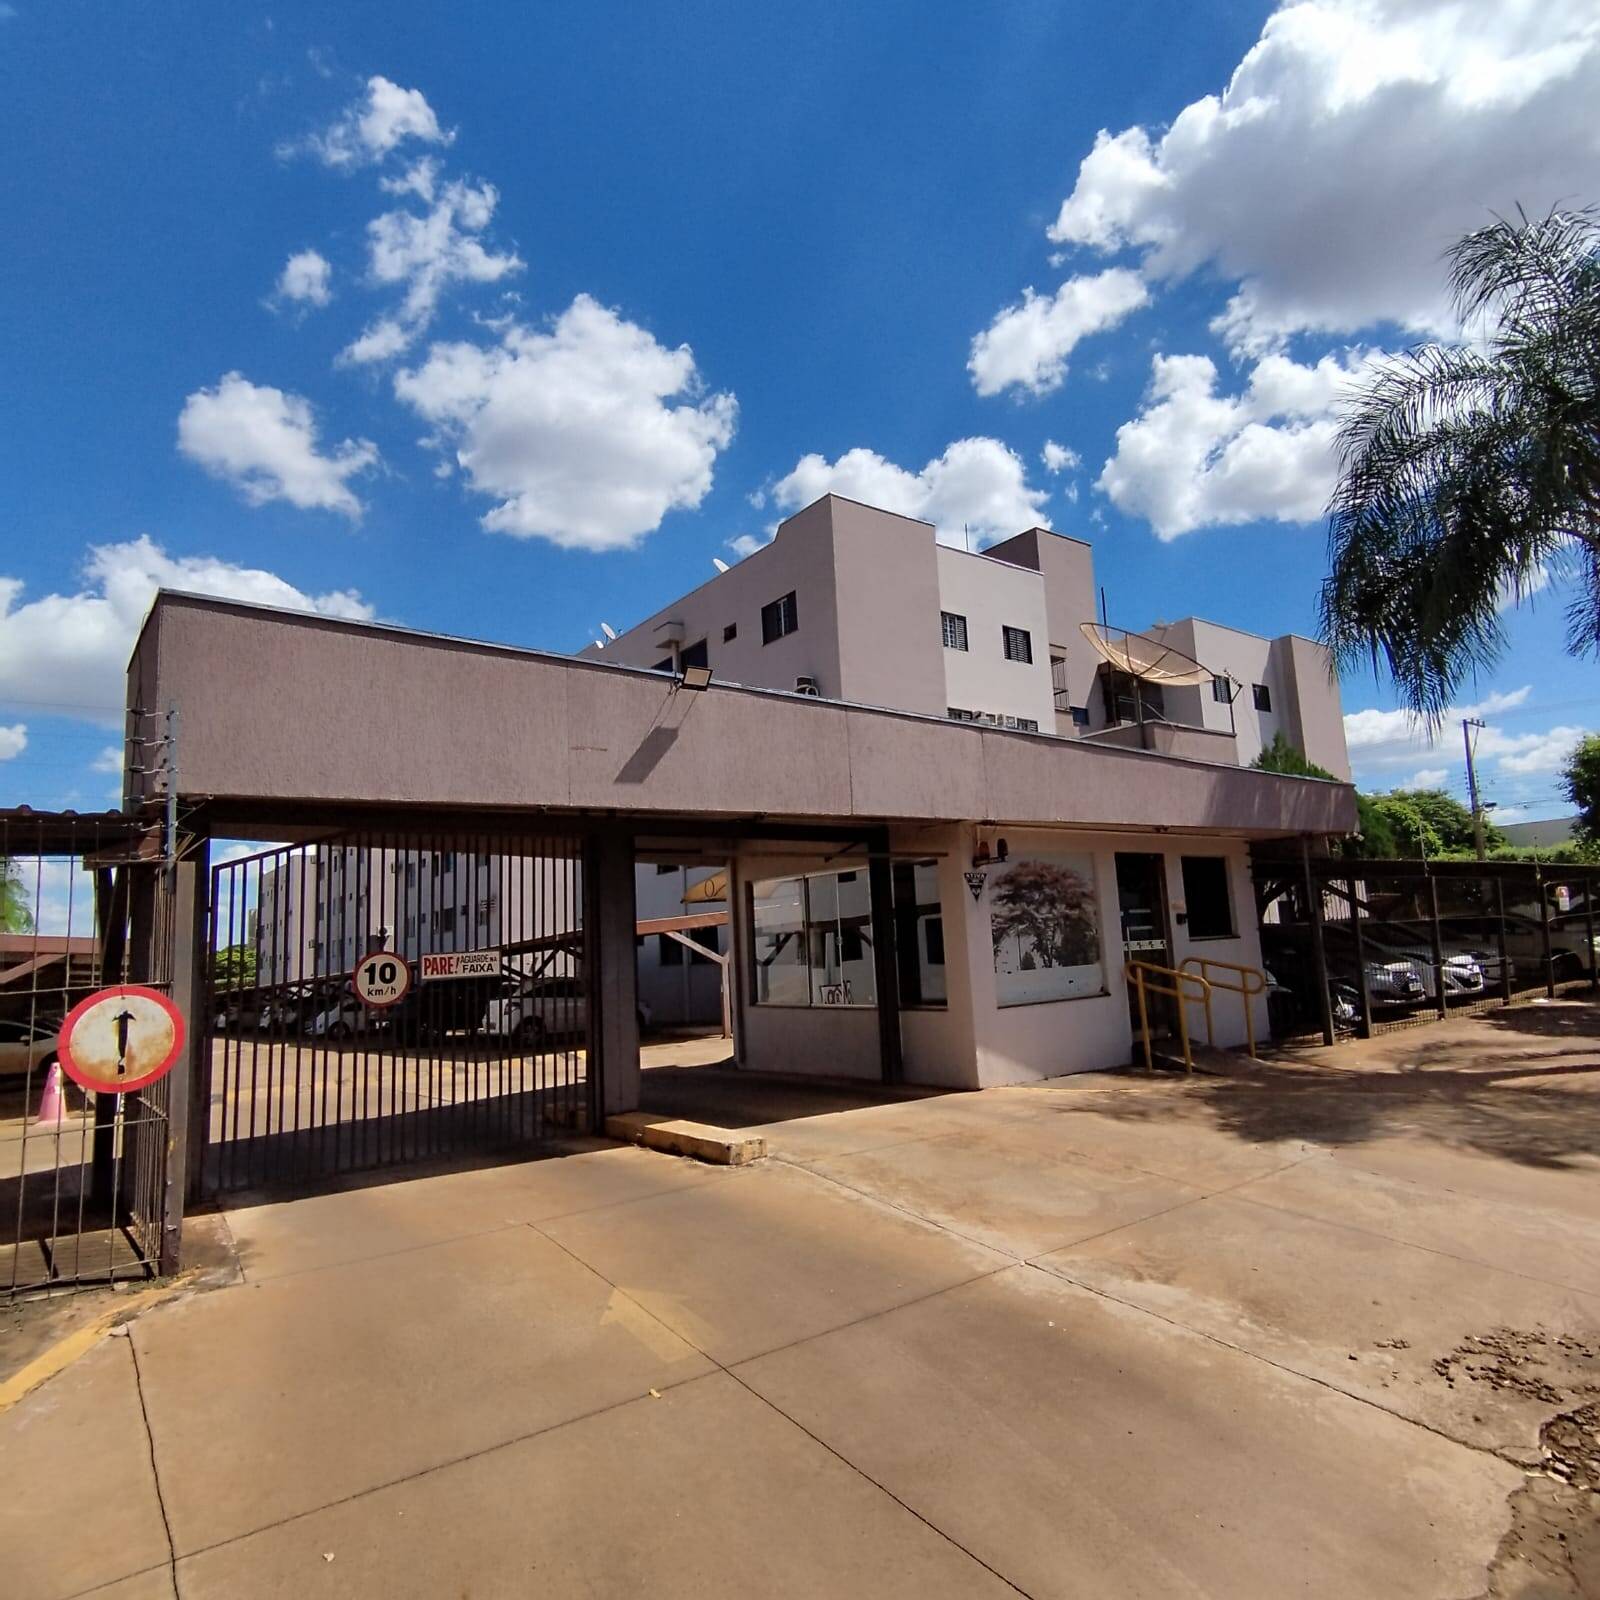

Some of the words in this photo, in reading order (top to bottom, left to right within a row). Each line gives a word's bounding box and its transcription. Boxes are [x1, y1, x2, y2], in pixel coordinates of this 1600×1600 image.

[460, 954, 489, 963] AGUARDE
[424, 956, 460, 976] PARE!
[462, 963, 494, 974] FAIXA
[364, 962, 397, 986] 10
[367, 986, 397, 997] km/h
